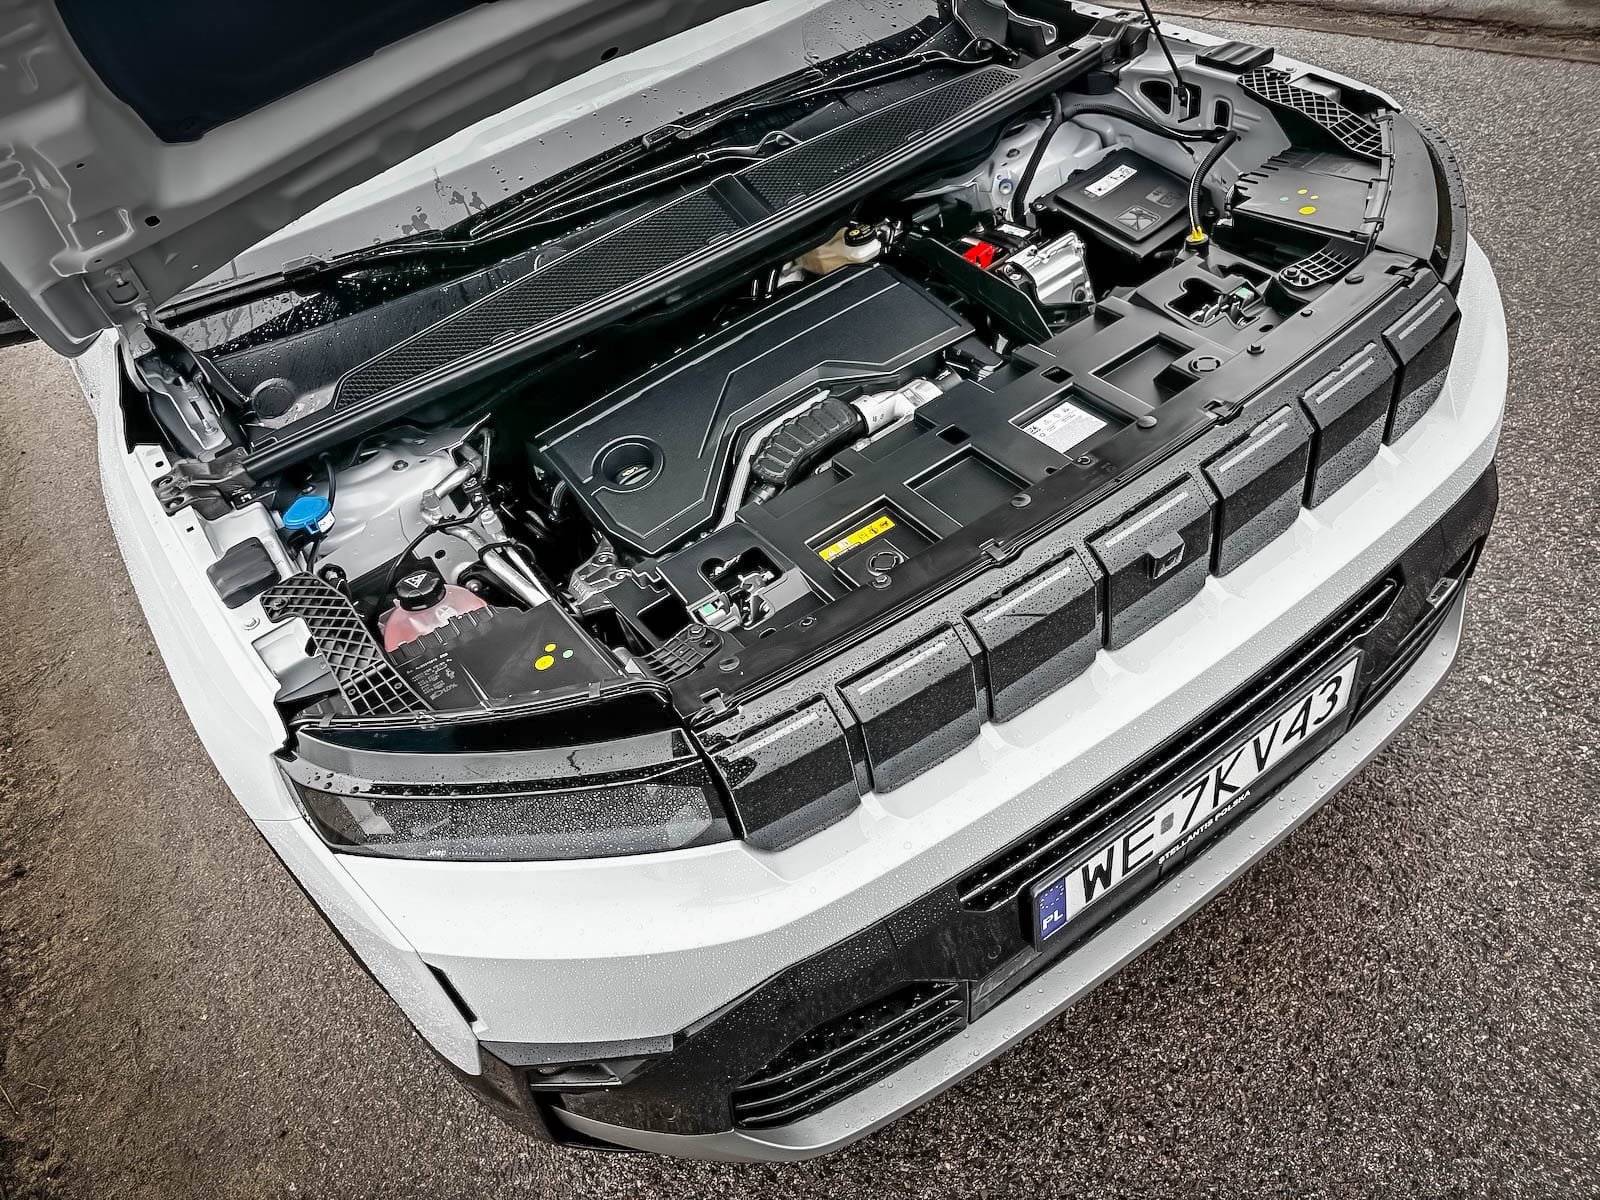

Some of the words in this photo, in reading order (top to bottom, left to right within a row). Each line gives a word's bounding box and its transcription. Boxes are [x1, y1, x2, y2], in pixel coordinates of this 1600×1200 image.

[1081, 815, 1156, 904] WE
[1180, 675, 1343, 835] 7KV43
[1158, 818, 1213, 865] STELLANTIS
[1214, 789, 1251, 822] POLSKA
[1042, 908, 1064, 930] PL
